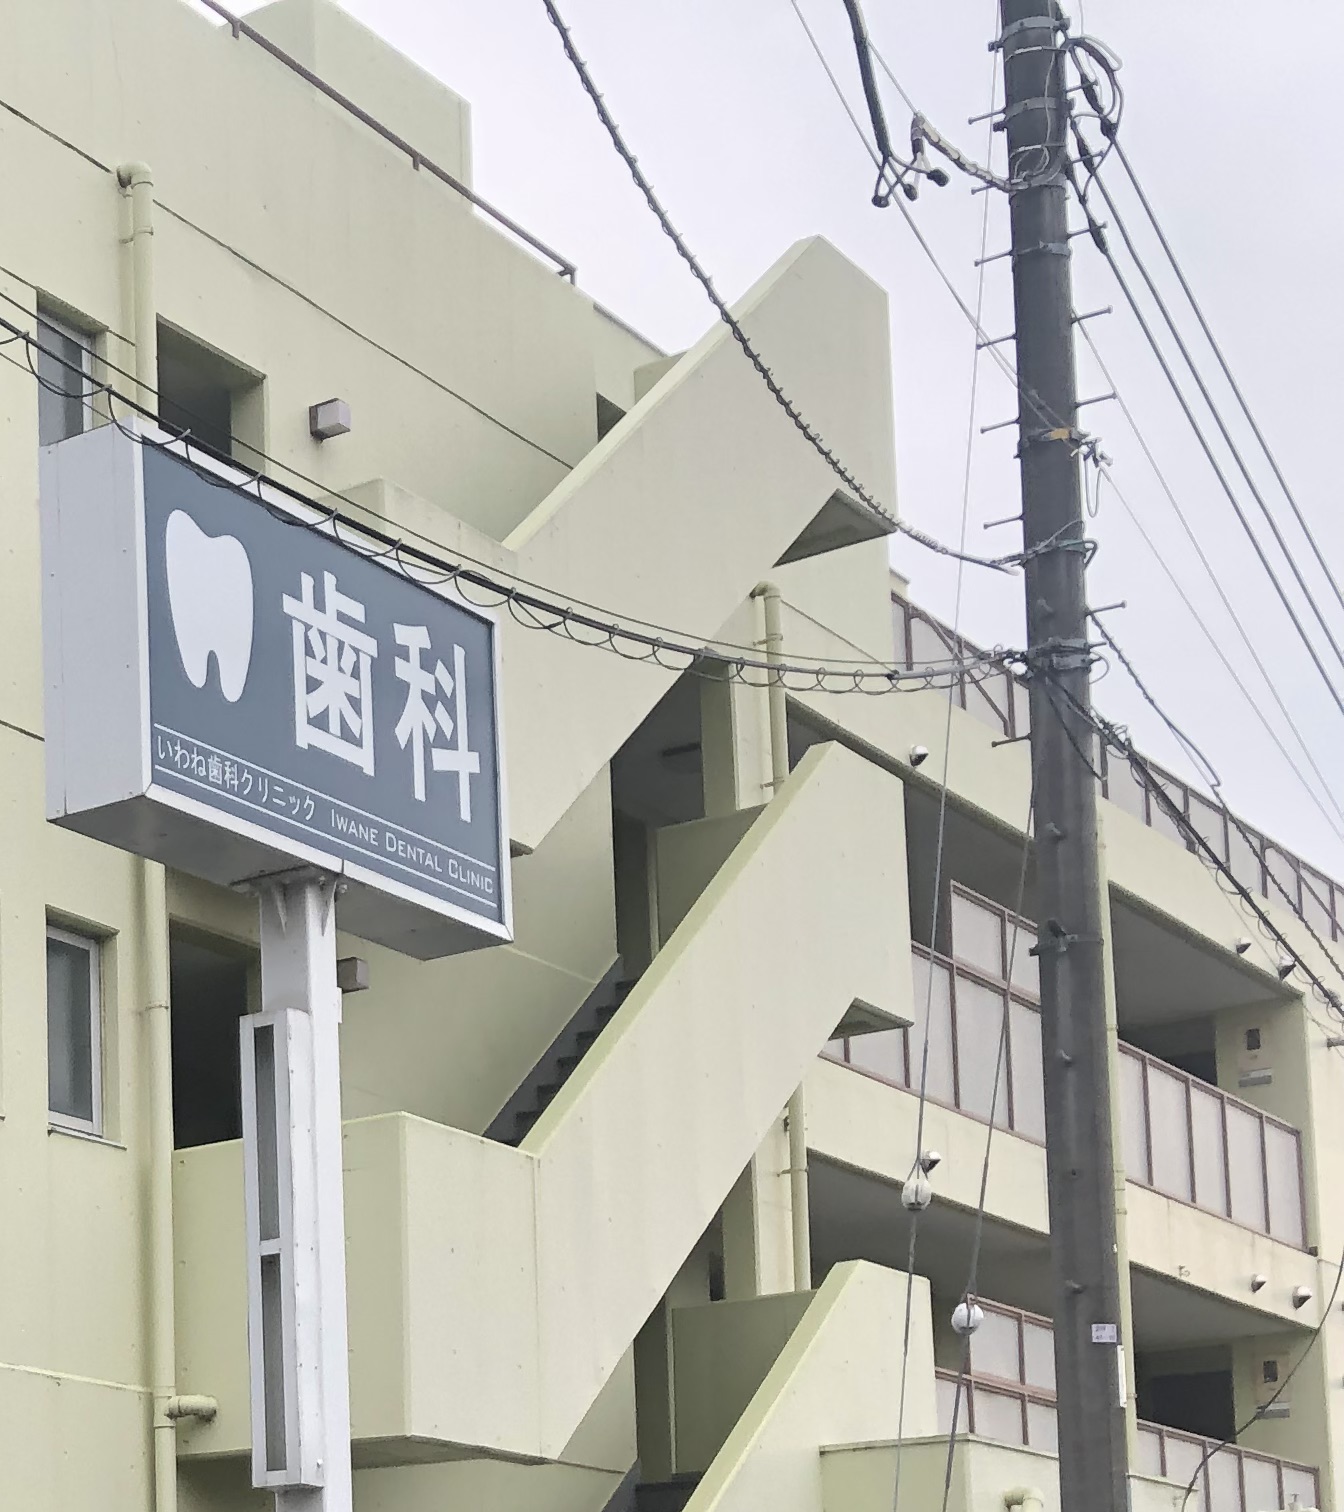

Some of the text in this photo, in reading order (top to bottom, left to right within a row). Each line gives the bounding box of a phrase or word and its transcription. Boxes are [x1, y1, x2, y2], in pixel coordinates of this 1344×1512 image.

[157, 735, 315, 821] いわね歯科クリニック
[281, 570, 480, 823] 歯科
